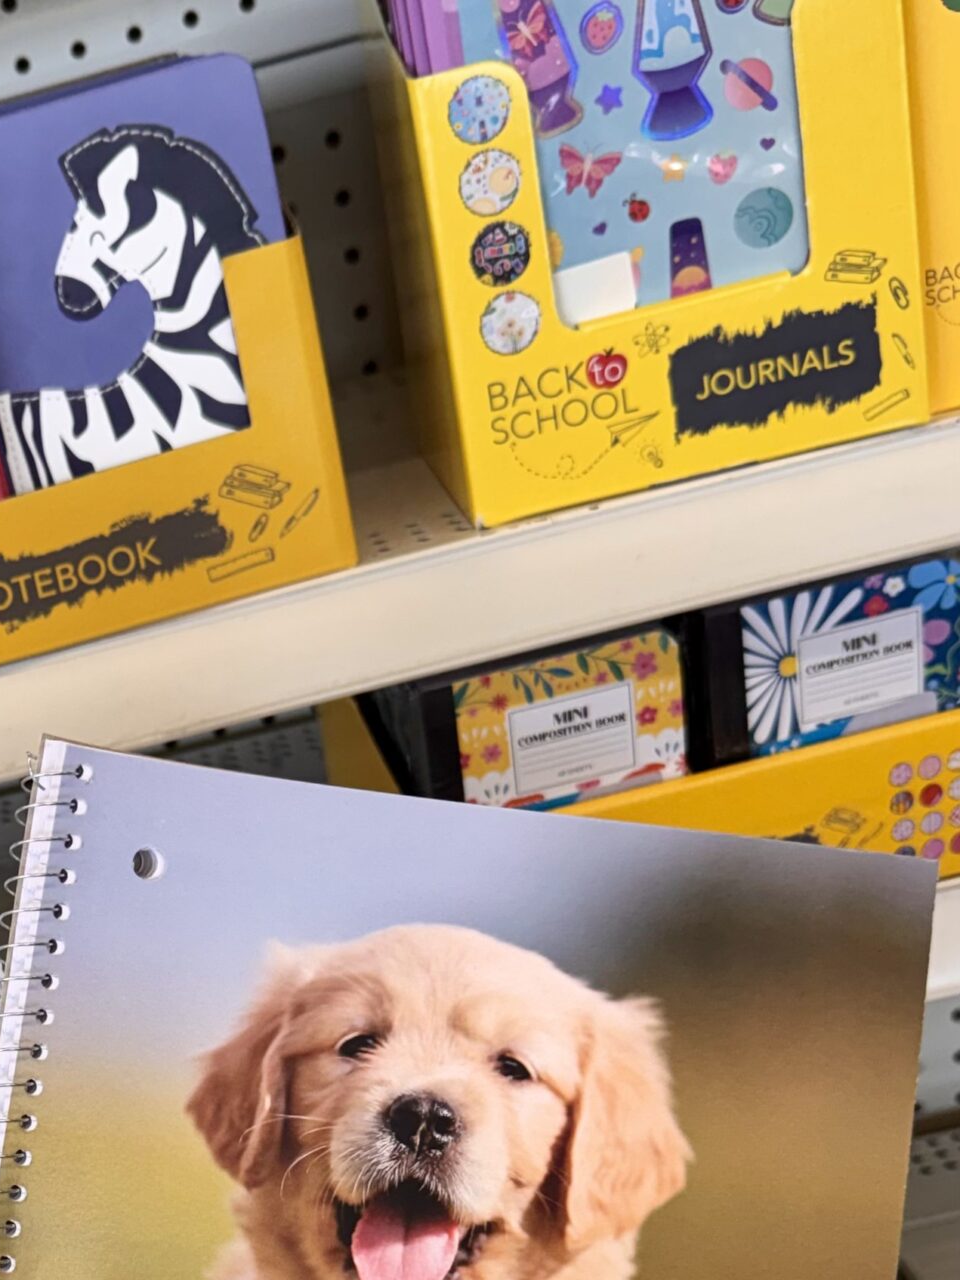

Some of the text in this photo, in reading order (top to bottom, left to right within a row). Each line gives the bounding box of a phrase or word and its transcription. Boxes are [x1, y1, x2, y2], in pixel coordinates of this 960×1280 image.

[487, 356, 624, 412] BACK to
[695, 338, 857, 401] JOURNALS
[490, 387, 640, 445] SCHOOL
[804, 639, 915, 676] COMPOSITION BOOK
[840, 632, 878, 655] MINI
[517, 712, 628, 749] COMPOSITION BOOK
[552, 705, 589, 729] MINI
